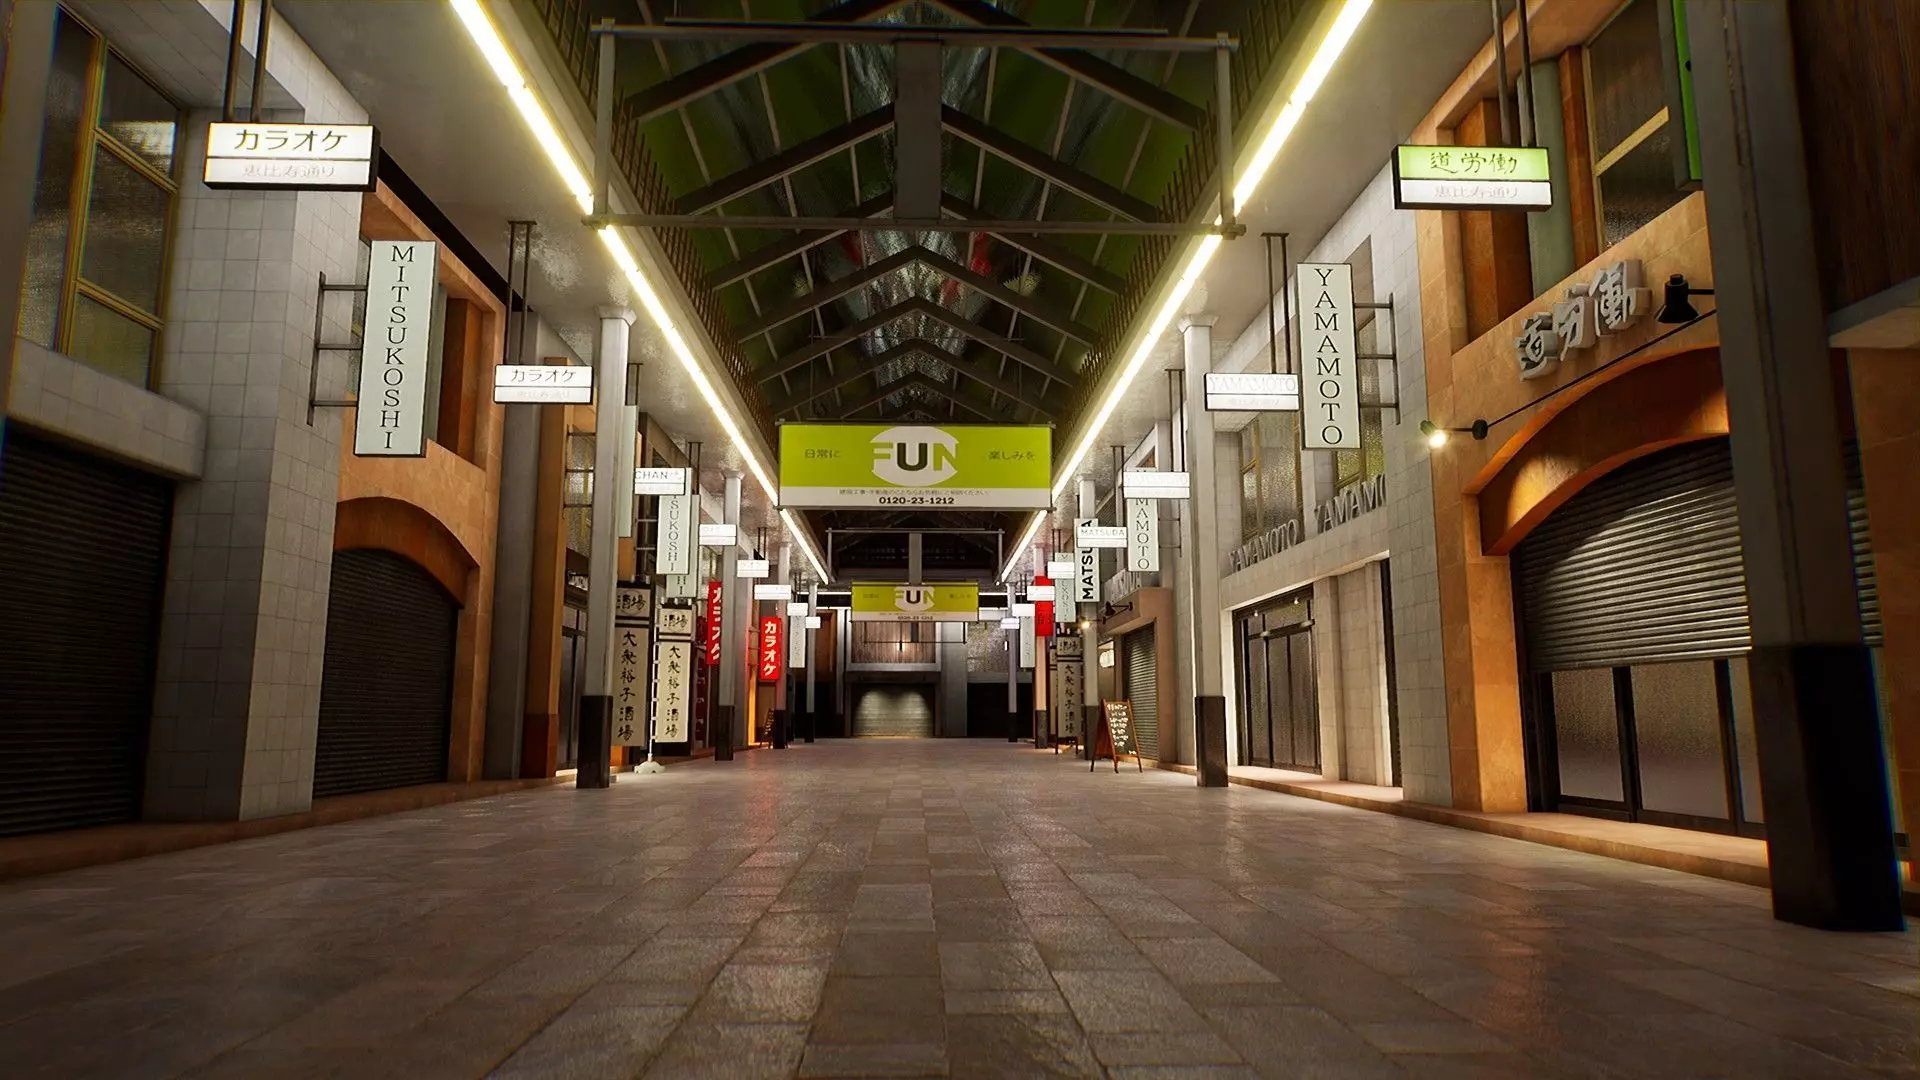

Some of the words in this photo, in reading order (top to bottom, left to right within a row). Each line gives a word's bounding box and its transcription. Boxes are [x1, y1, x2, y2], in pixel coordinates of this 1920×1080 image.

[233, 128, 348, 152] カラオケ
[1430, 151, 1517, 174] 道労働
[379, 244, 415, 450] MITSUKOSHI
[1314, 268, 1343, 445] YAMAMOTO
[511, 368, 577, 383] カラオケ
[804, 448, 840, 459] 日常に
[872, 442, 958, 472] FUN
[878, 497, 955, 505] 0120-23-1212
[1080, 528, 1125, 537] MATSUDA
[616, 594, 646, 610] 酒場
[664, 614, 688, 628] 酒場
[764, 621, 777, 676] カラオケ
